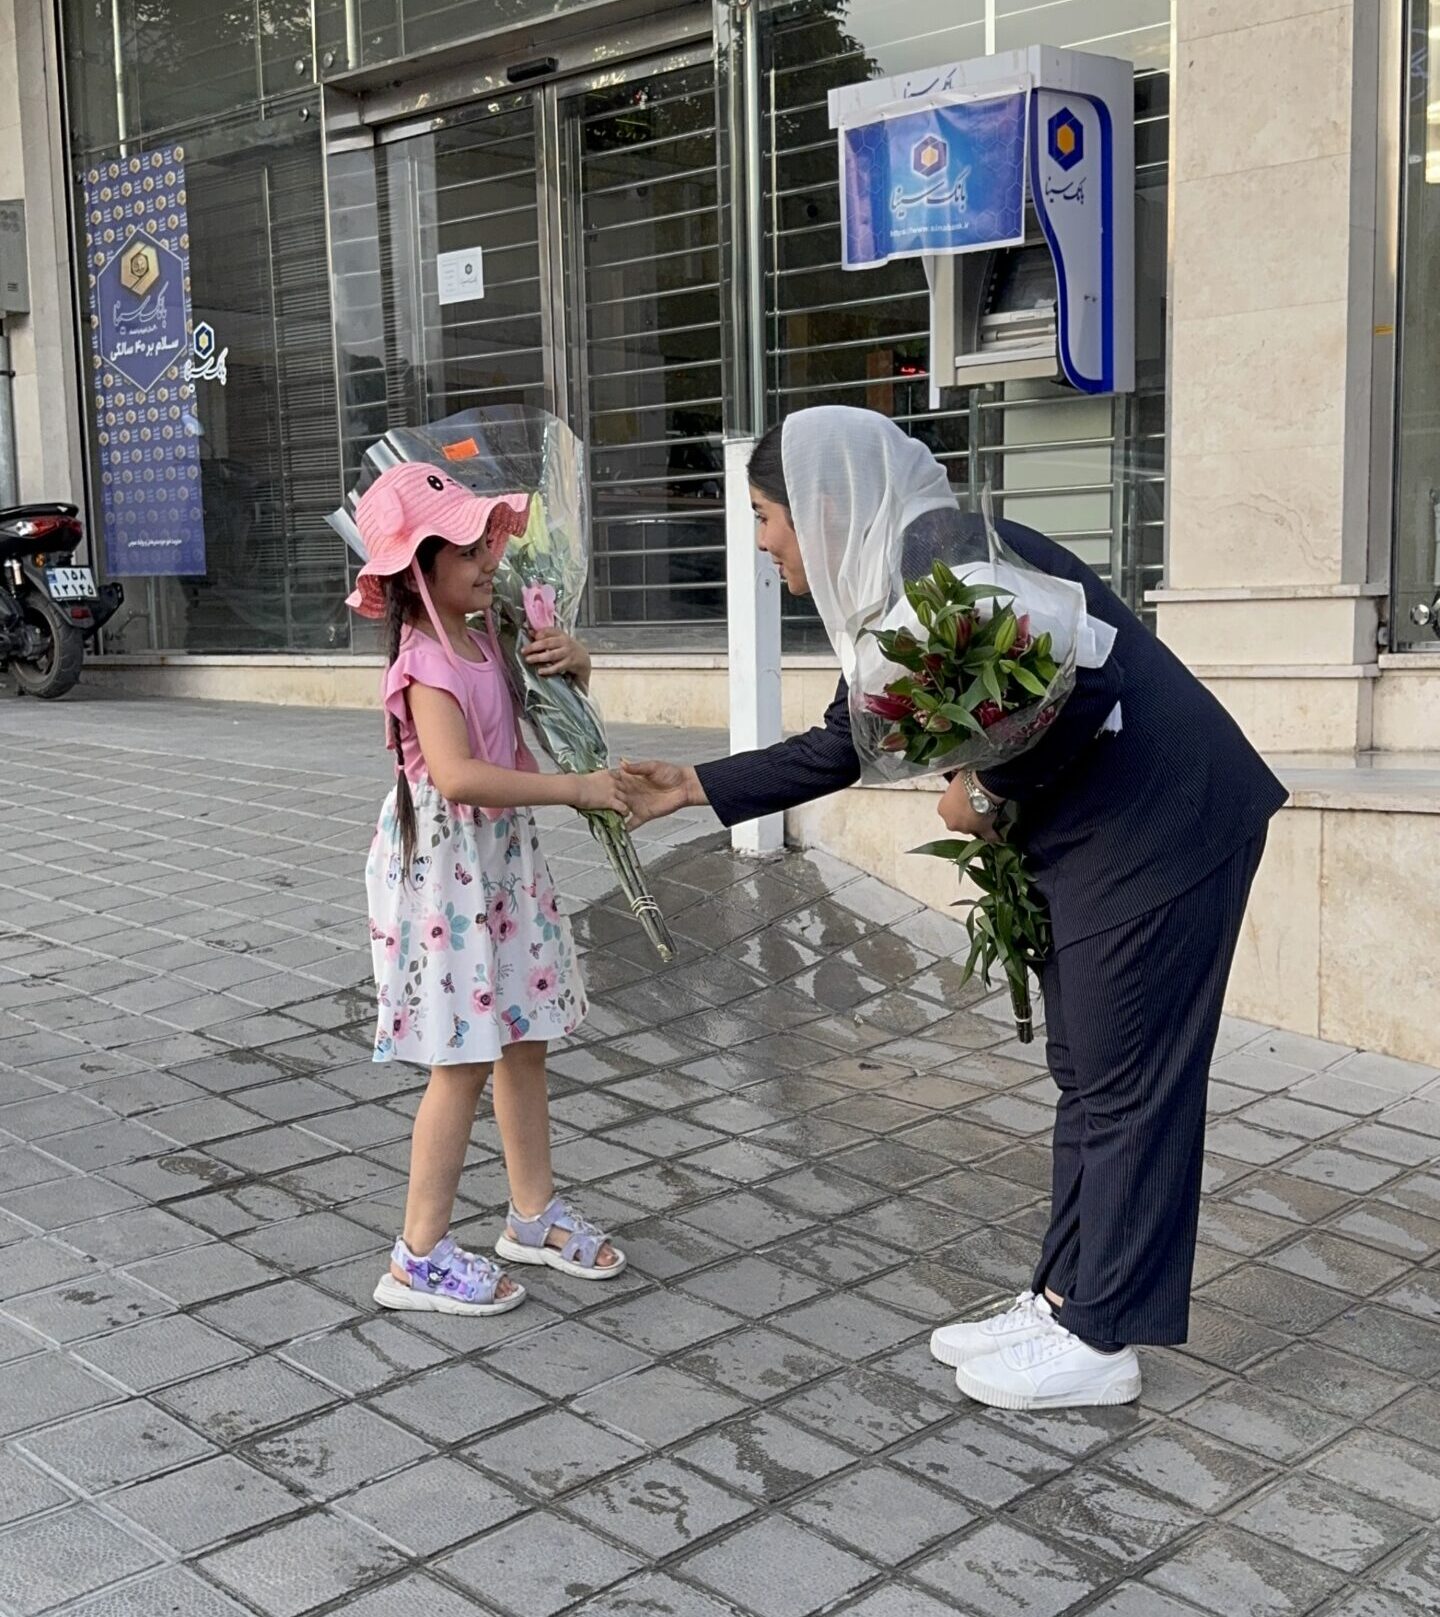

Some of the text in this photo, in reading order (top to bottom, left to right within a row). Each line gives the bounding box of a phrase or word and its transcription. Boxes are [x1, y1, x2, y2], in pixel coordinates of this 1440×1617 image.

[890, 165, 971, 219] بانک سینا
[1045, 175, 1087, 205] بانک سینا
[113, 281, 169, 335] بانک سینا
[109, 341, 134, 362] سالگی
[145, 342, 155, 357] بر
[155, 335, 179, 357] سلام
[203, 347, 228, 386] بانک
[62, 569, 87, 581] ۱۵۸
